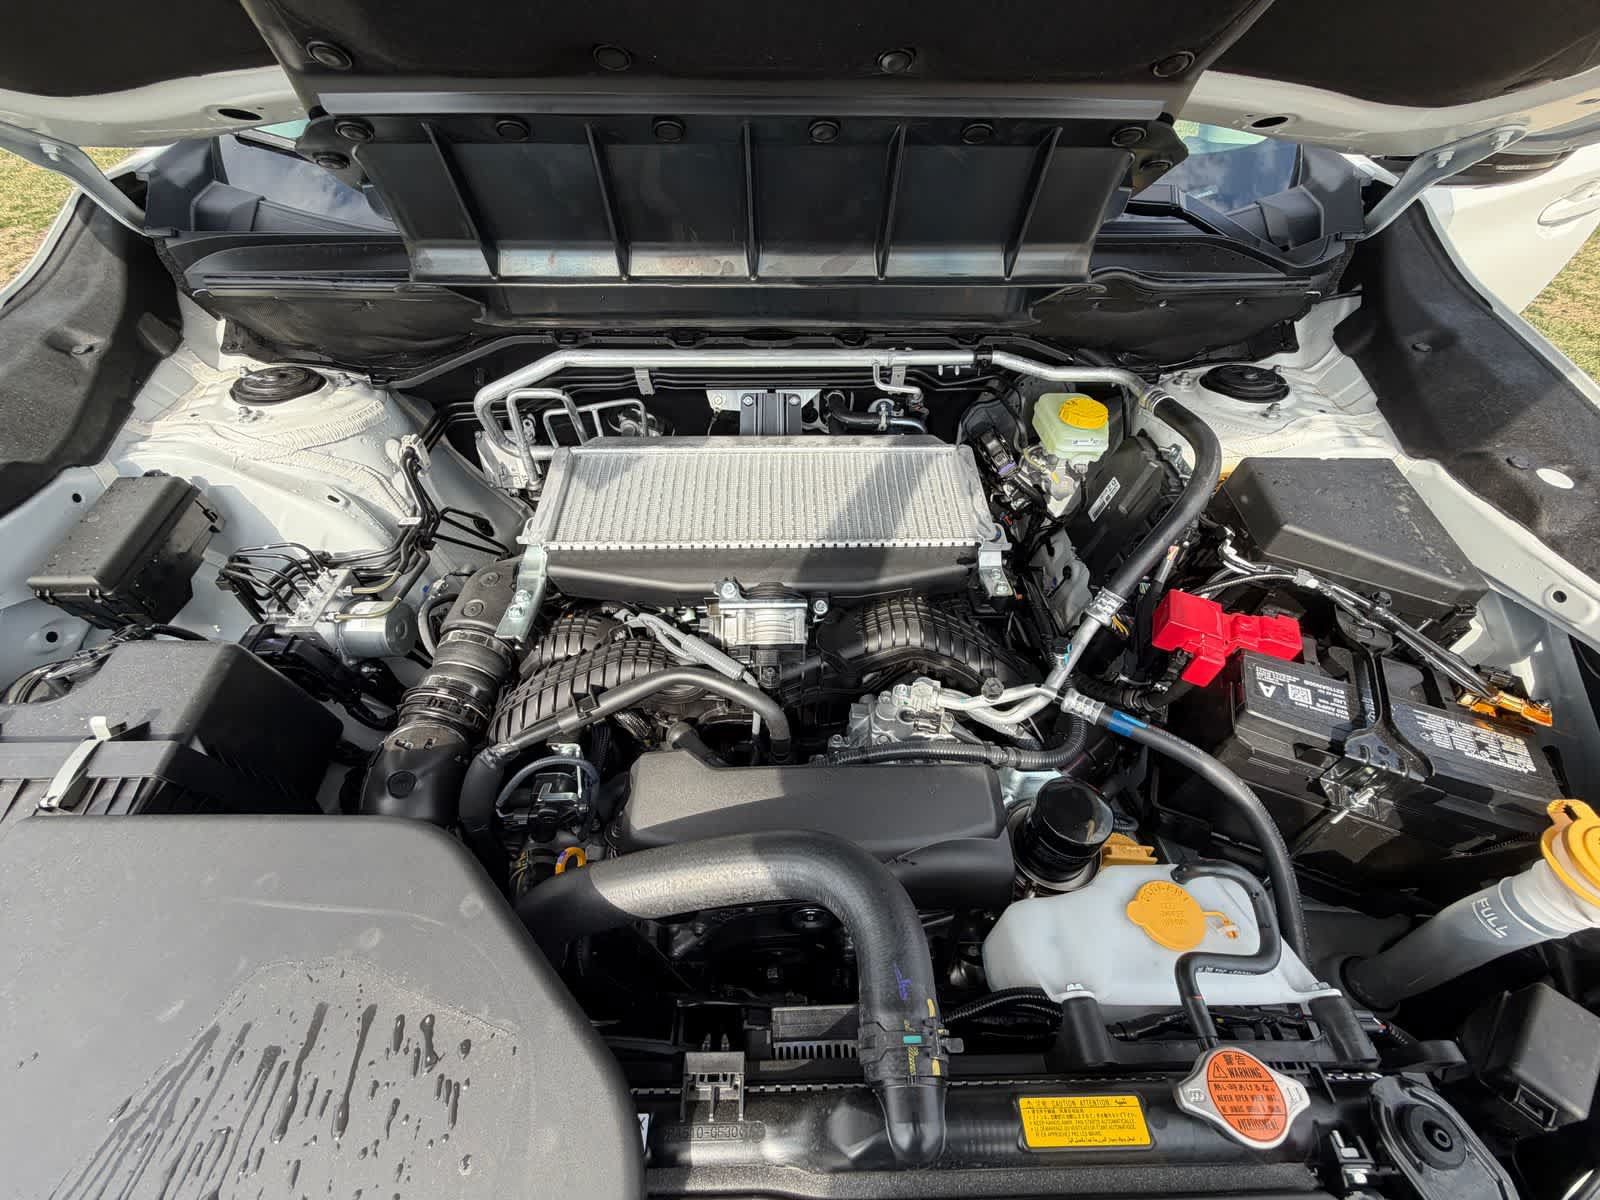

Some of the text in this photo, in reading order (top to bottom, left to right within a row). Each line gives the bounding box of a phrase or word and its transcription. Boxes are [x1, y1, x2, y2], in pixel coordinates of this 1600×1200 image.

[1476, 896, 1508, 937] FULL
[1227, 1067, 1263, 1079] WARNING
[1217, 1094, 1233, 1102] NEVER
[1235, 1094, 1249, 1102] OPEN
